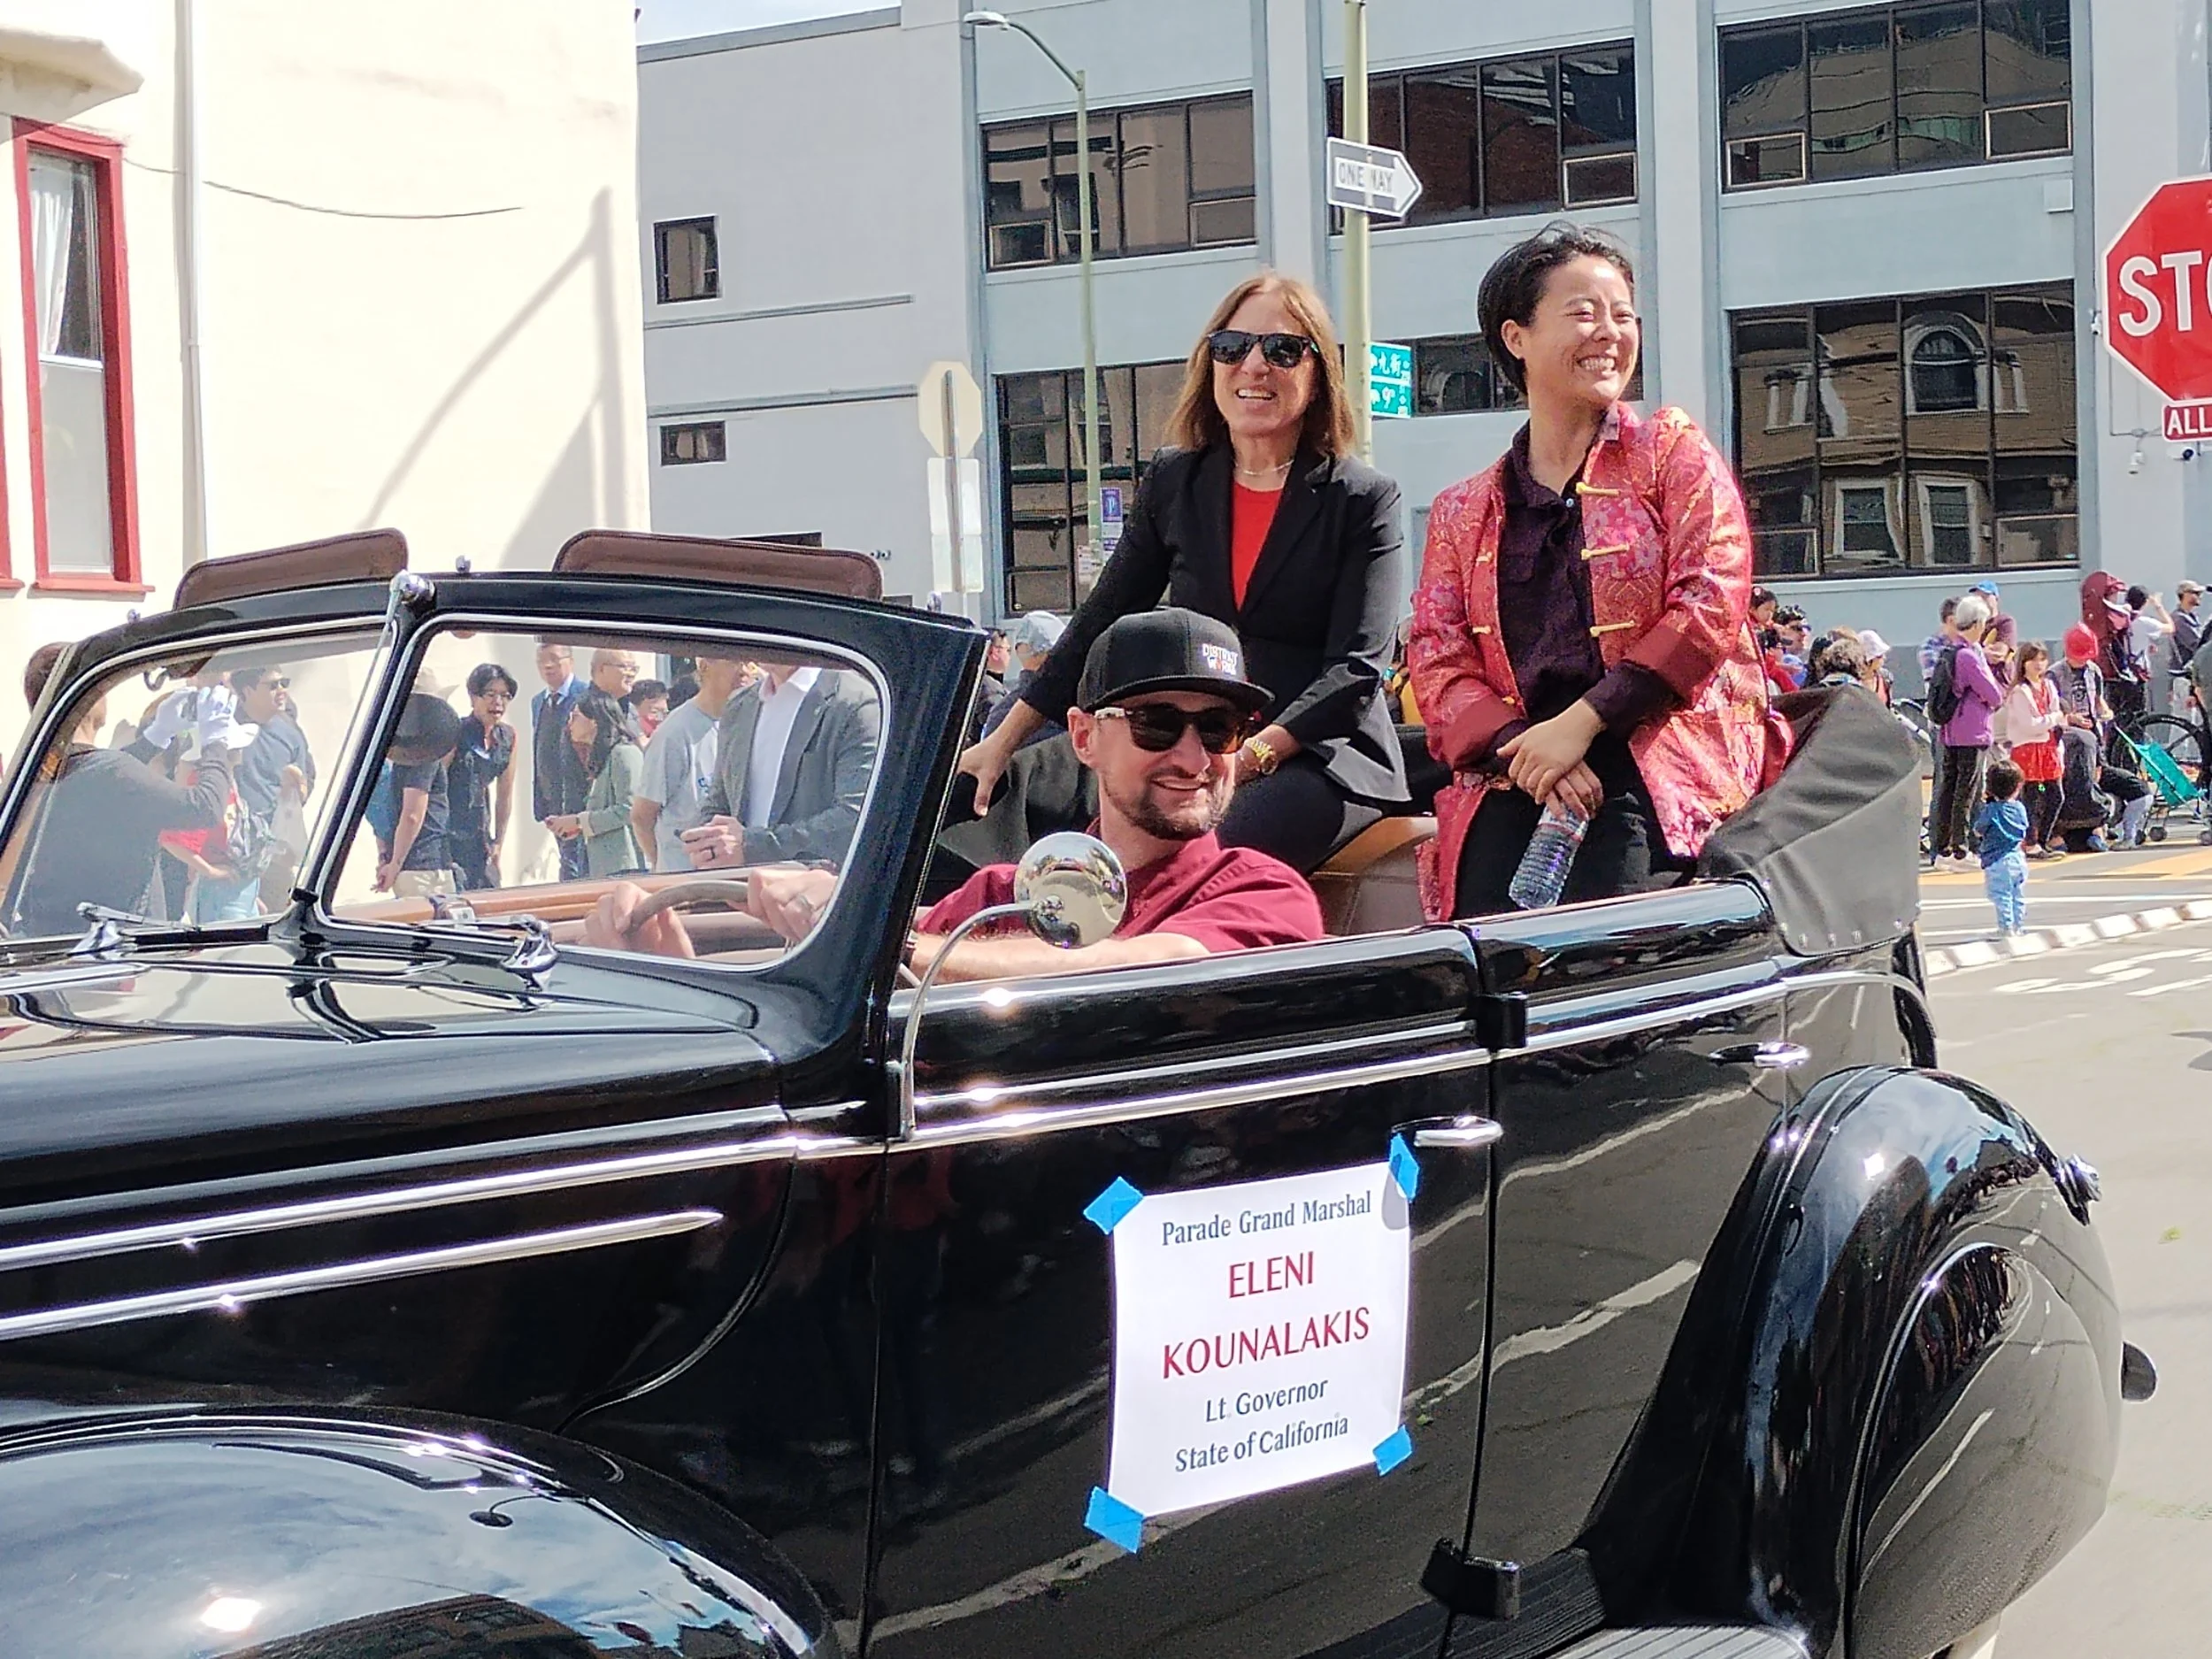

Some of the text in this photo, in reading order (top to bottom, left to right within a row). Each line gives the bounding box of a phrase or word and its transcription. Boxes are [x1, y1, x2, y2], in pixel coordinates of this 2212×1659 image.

[1338, 162, 1365, 188] ONE
[1162, 1190, 1371, 1246] Parade Grand Marshal
[1228, 1251, 1314, 1299] ELENI
[1163, 1306, 1370, 1379] KOUNALAKIS
[1235, 1379, 1328, 1416] Governor
[1175, 1414, 1348, 1472] State of California
